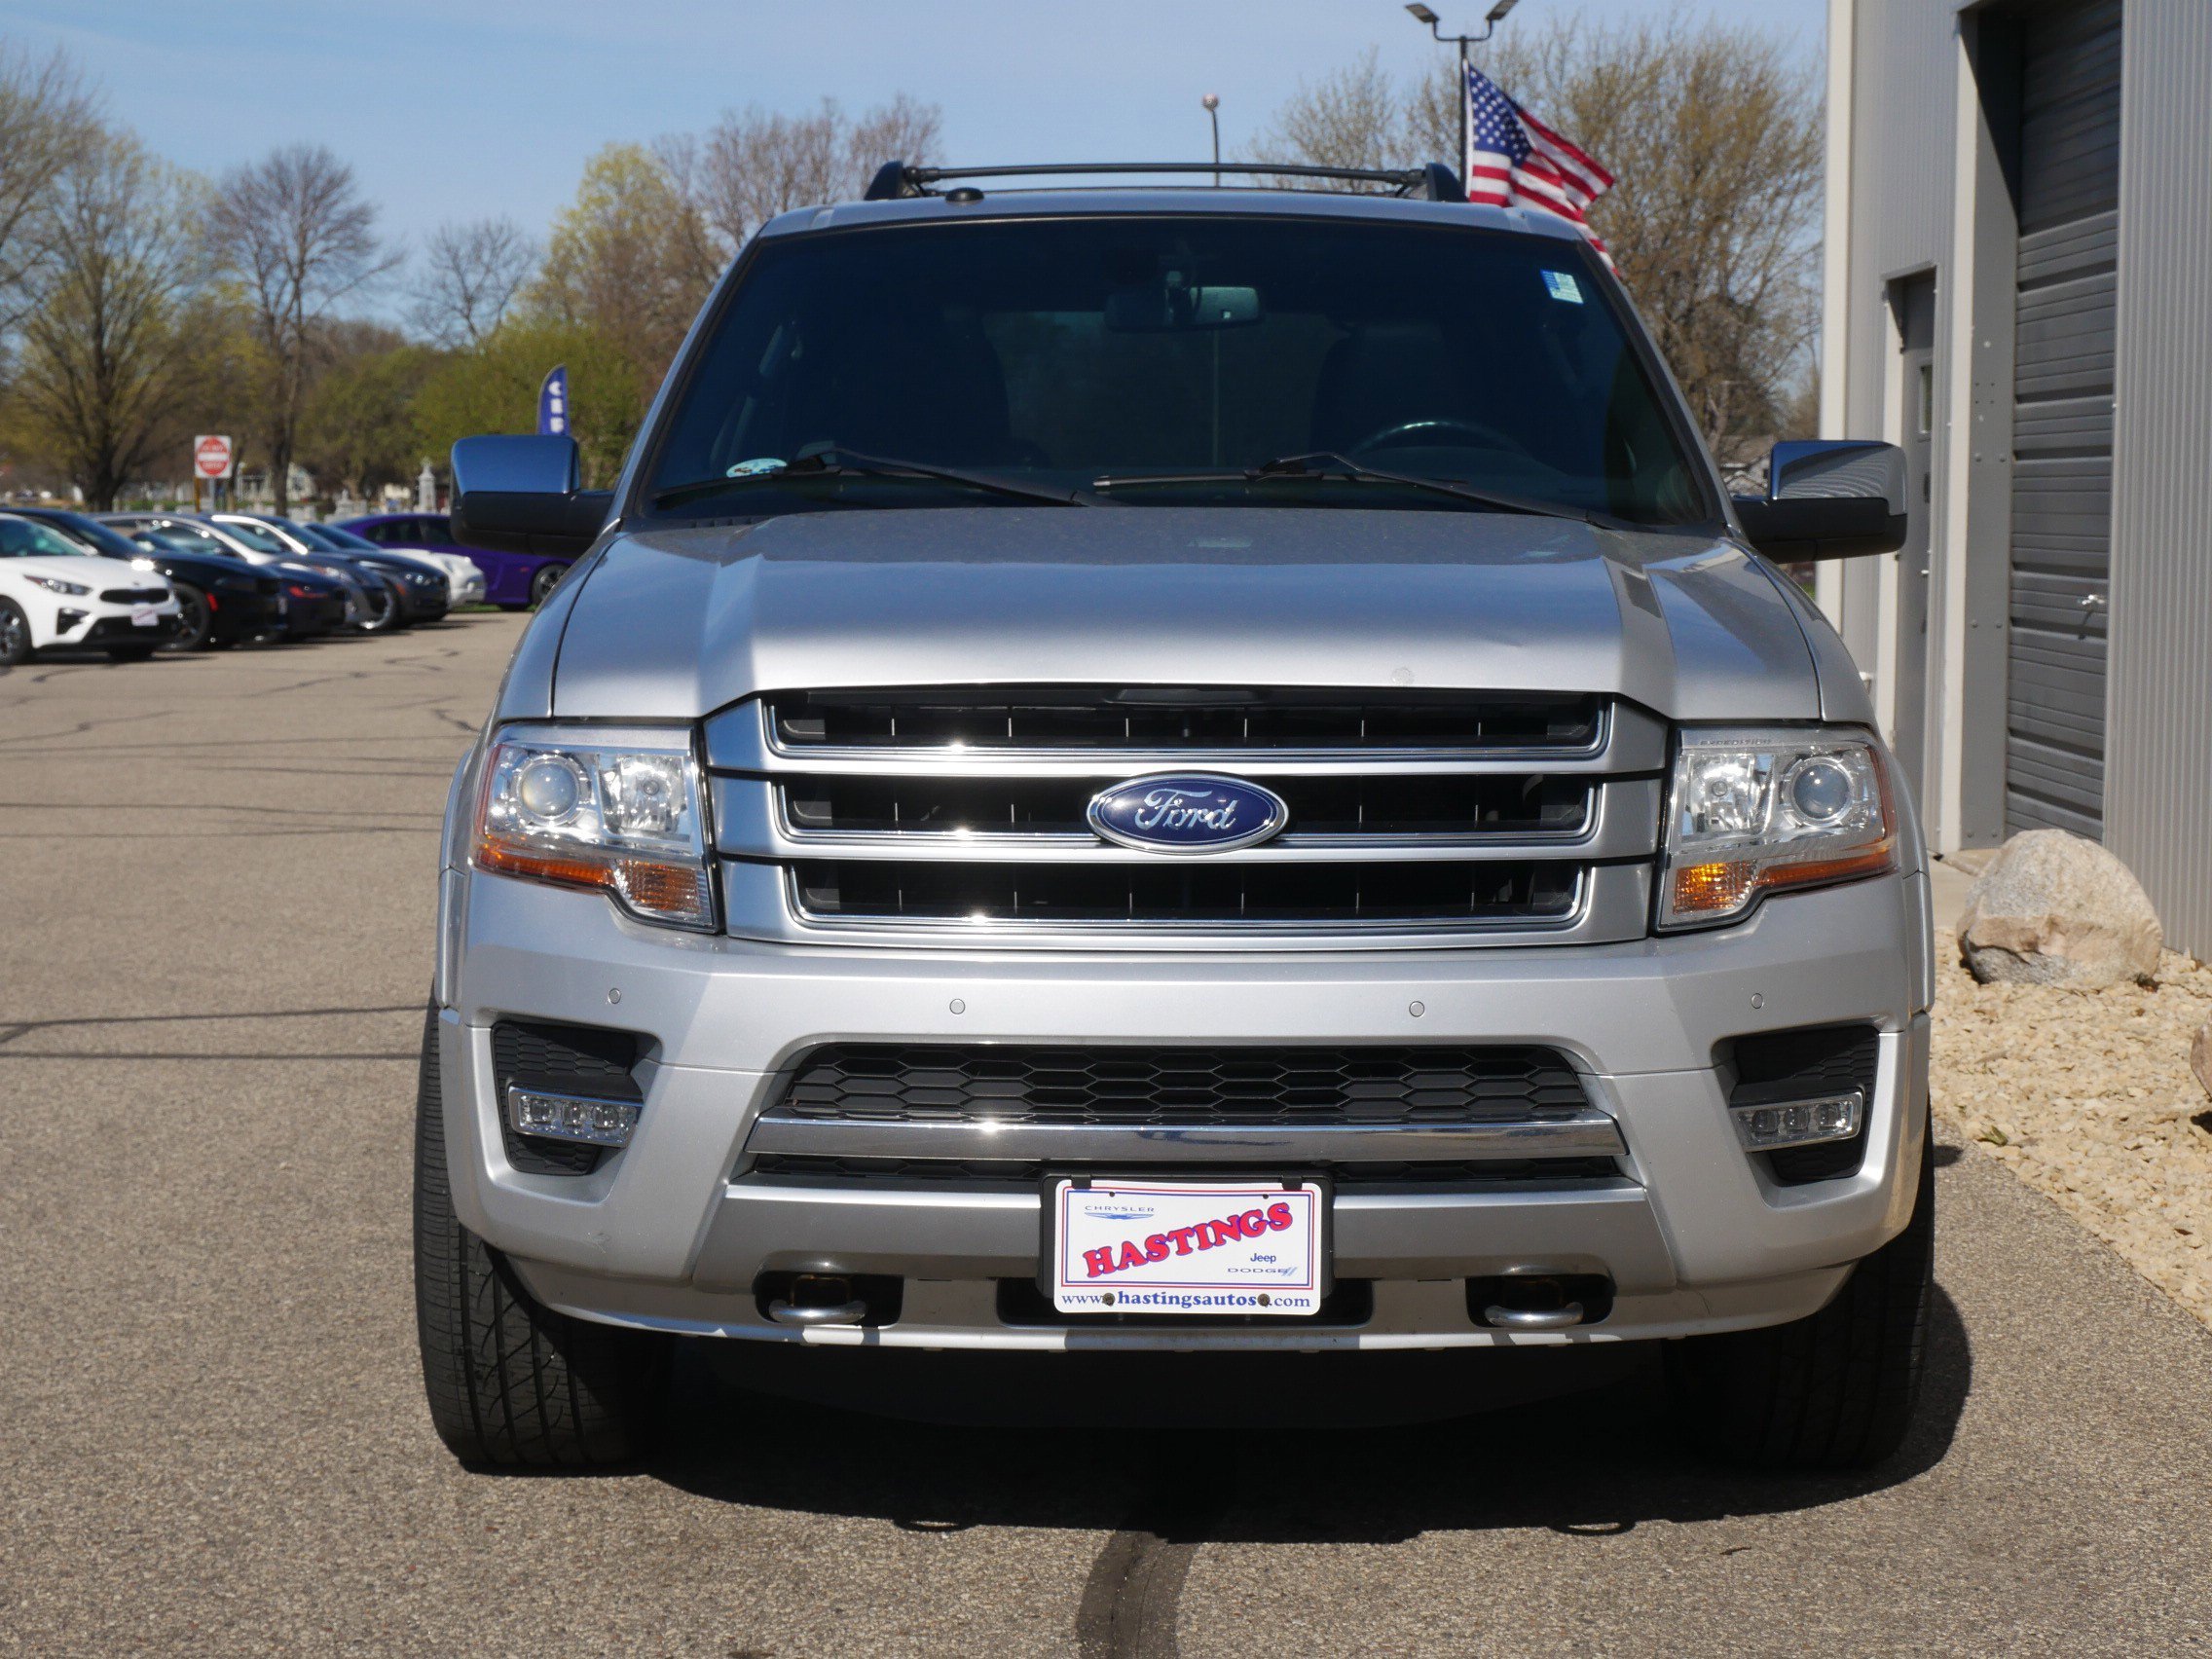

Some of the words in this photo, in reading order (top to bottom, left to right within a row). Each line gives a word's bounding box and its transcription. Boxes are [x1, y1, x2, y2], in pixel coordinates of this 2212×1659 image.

[1134, 788, 1238, 830] Ford
[1083, 1201, 1294, 1278] HASTINGS
[1250, 1252, 1276, 1264] Jeep
[1061, 1290, 1310, 1309] wwwhastingsautoscom
